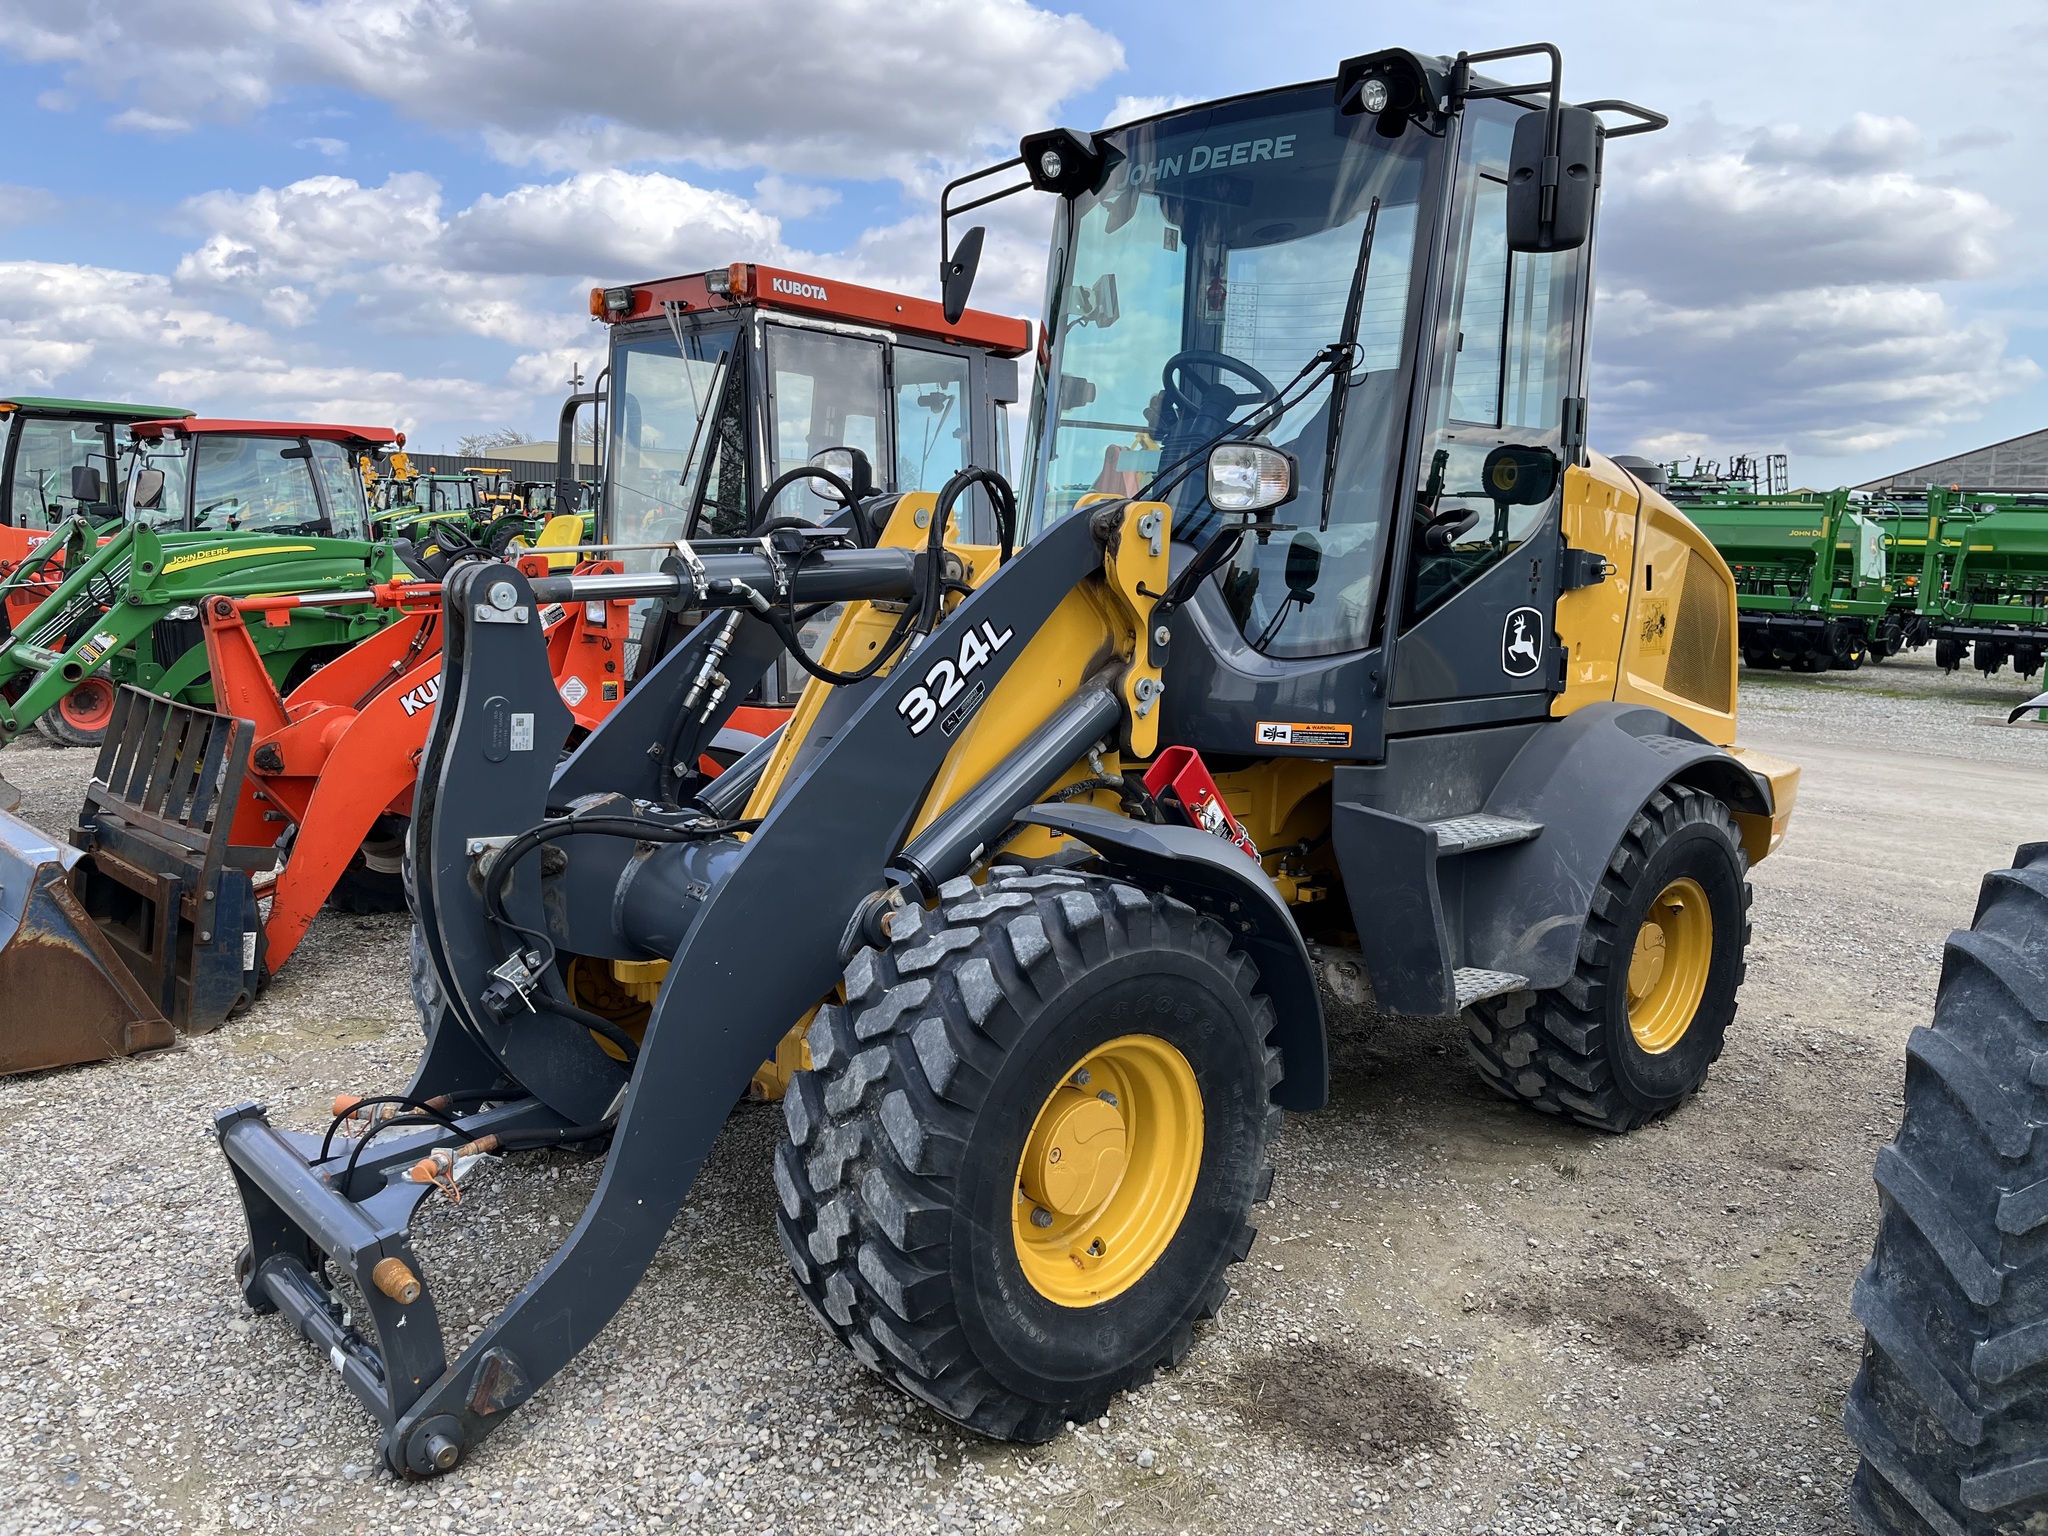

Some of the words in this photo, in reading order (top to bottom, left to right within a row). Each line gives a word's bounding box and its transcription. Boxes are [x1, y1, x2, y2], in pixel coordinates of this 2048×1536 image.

[1116, 154, 1185, 190] JOHN
[1187, 134, 1297, 174] DEERE
[772, 277, 828, 301] KUBOTA
[1789, 529, 1811, 537] JOHN
[170, 553, 197, 565] JOHN
[197, 547, 229, 560] DEERE
[897, 619, 1015, 735] 324L
